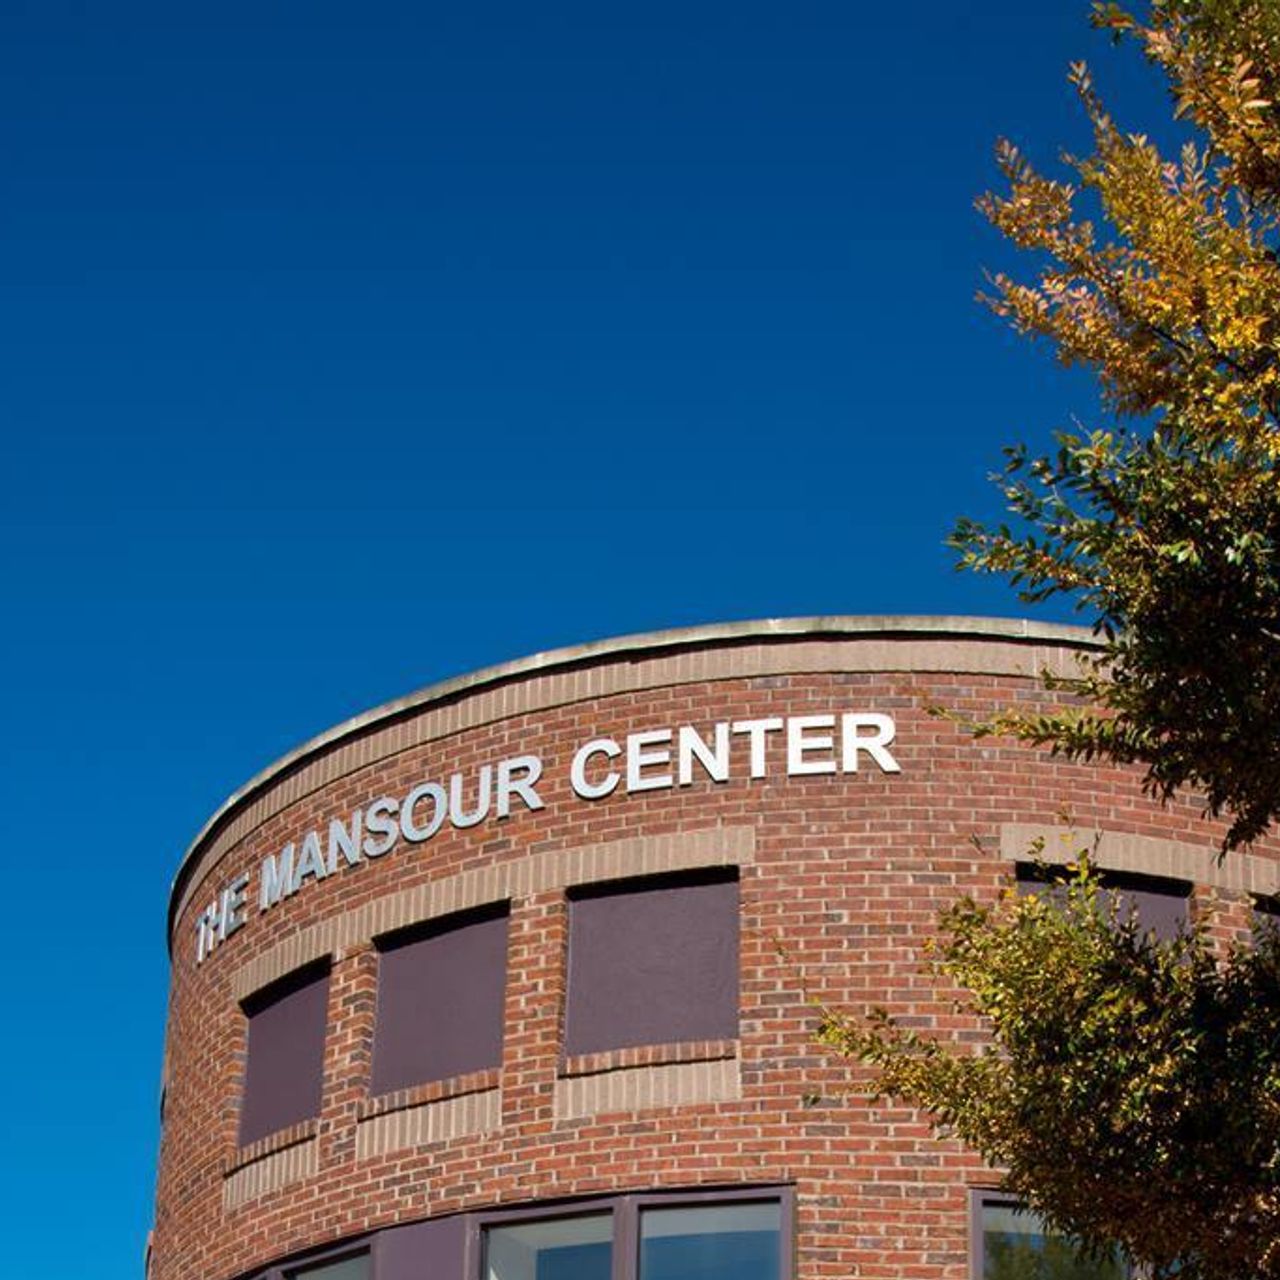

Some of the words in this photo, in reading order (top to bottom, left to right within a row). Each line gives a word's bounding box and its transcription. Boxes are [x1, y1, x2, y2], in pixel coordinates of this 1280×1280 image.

[195, 871, 250, 963] THE
[259, 756, 544, 911] MANSOUR
[571, 712, 901, 798] CENTER
